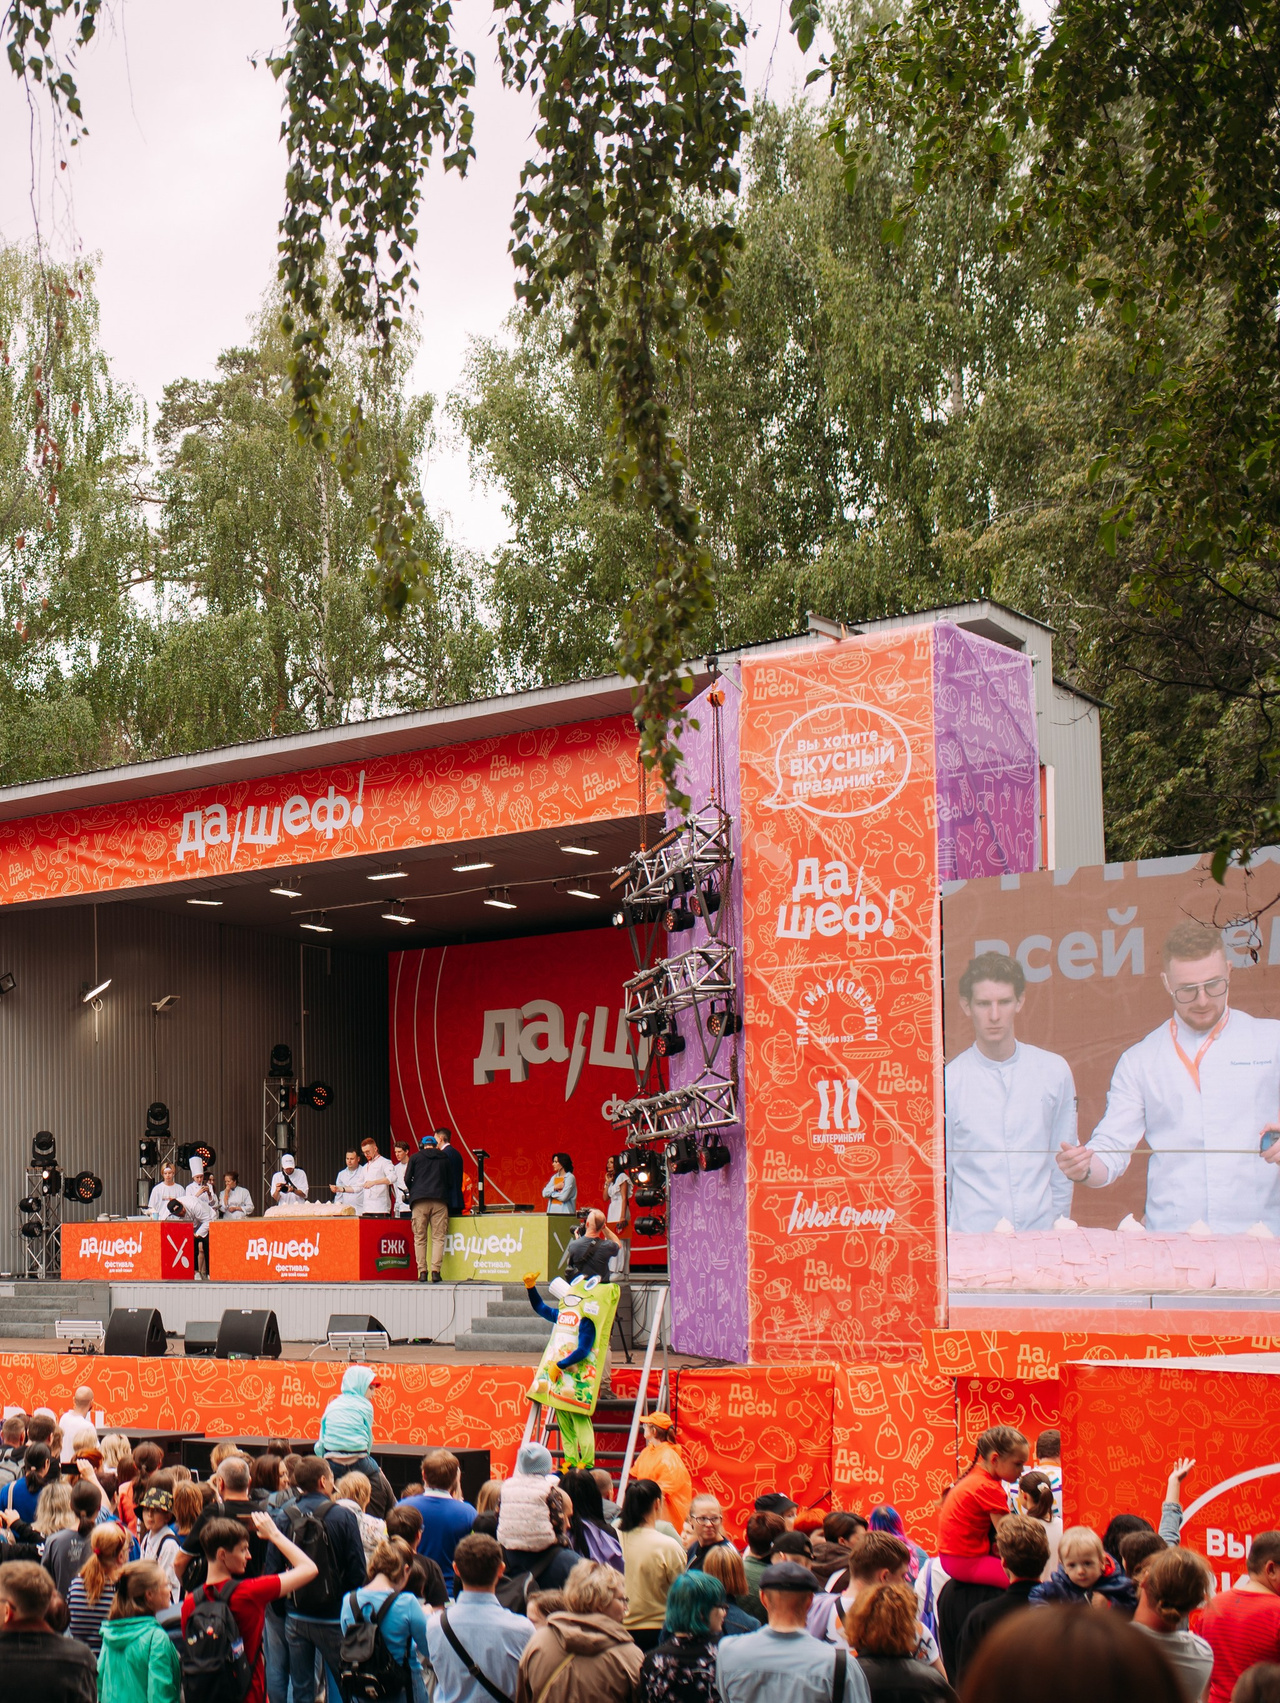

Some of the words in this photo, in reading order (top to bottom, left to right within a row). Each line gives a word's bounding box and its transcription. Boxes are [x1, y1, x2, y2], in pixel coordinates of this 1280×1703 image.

[823, 730, 879, 749] хотите
[790, 741, 896, 776] ВКУСНЫЙ
[813, 1132, 866, 1144] ЕКАТЕРИНБУРГ
[381, 1239, 405, 1254] ЕЖК
[728, 1398, 777, 1418] шеф!
[834, 1465, 884, 1486] шеф!
